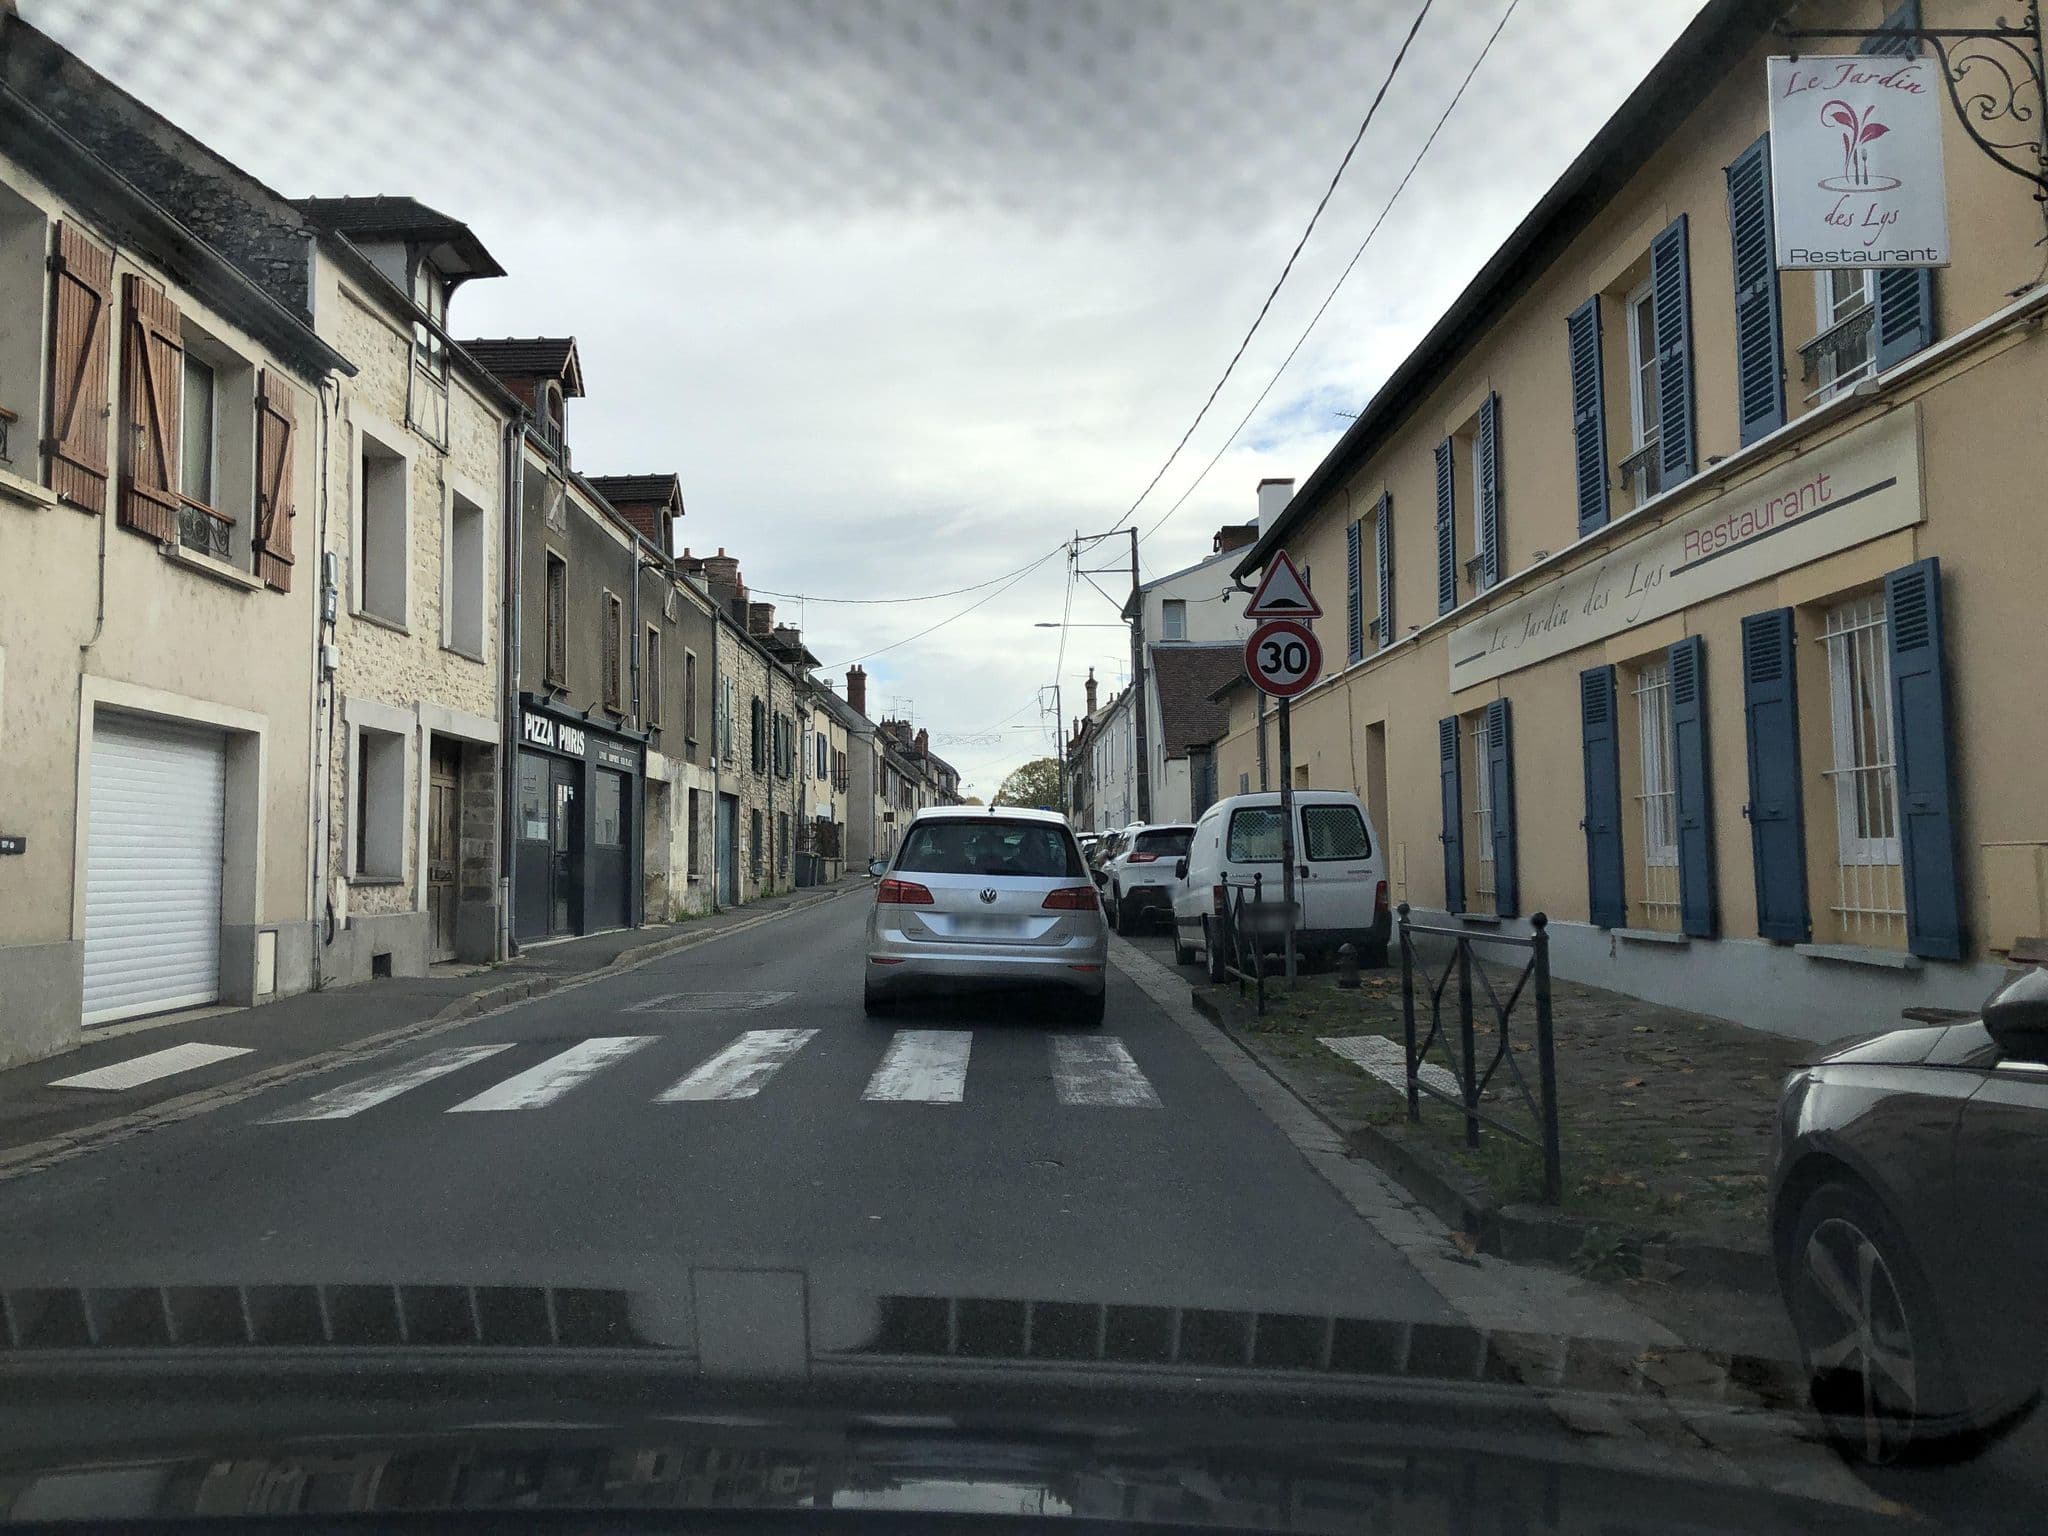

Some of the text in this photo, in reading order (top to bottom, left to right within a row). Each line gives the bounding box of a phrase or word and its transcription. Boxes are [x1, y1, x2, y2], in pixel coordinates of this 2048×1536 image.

[1784, 63, 1926, 98] Le Jardin
[1824, 194, 1900, 246] des Lys
[1790, 247, 1938, 264] Restaurant
[1488, 473, 1831, 654] Le Jardin des Lys Restaurant
[1260, 641, 1308, 675] 30
[525, 711, 554, 747] PIZZA
